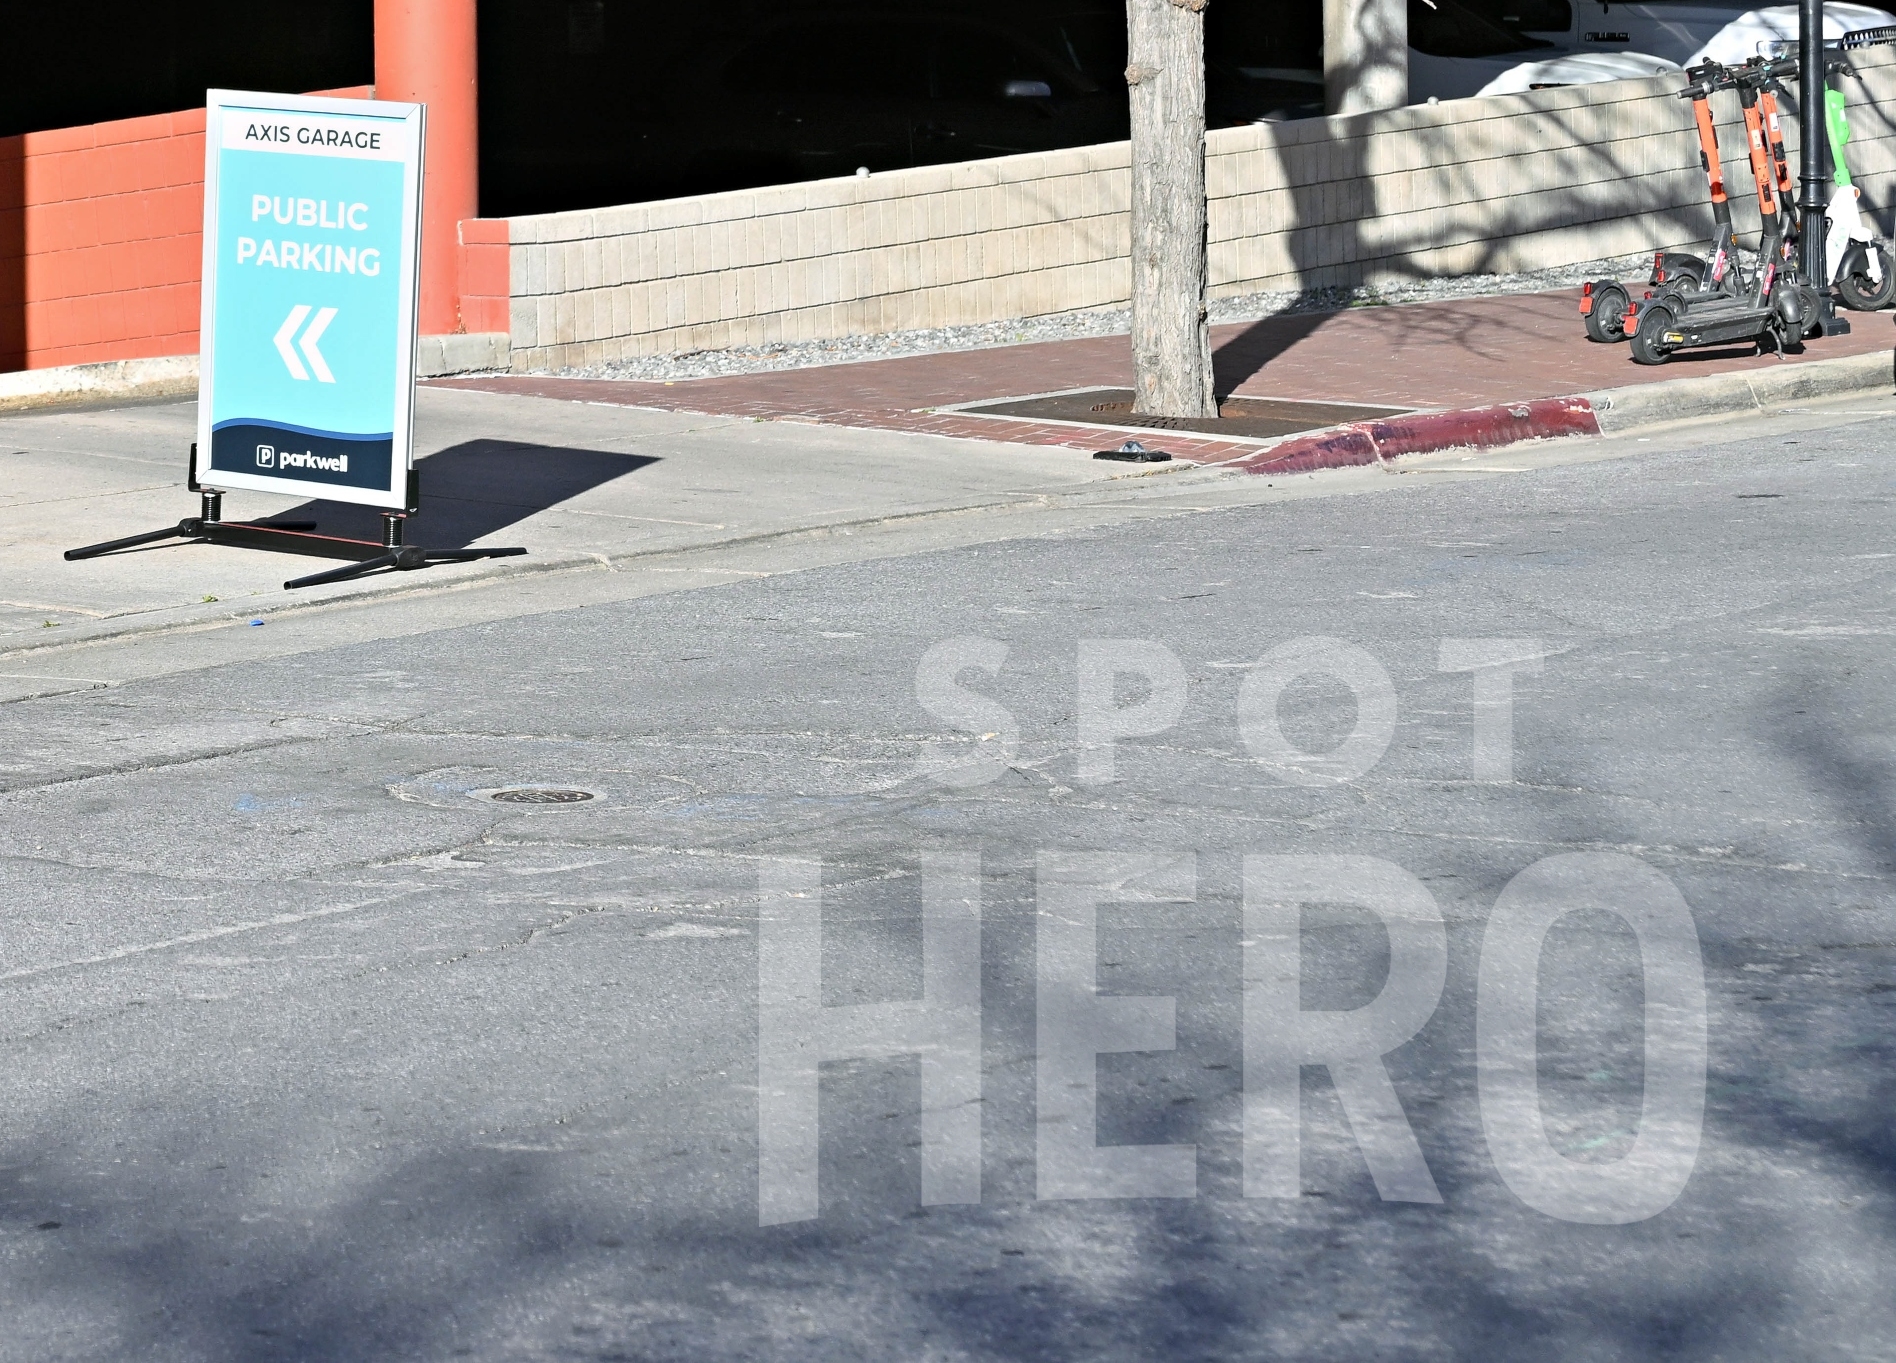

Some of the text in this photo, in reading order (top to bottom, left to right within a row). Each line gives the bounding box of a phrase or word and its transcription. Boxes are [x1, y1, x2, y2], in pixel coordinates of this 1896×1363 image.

[245, 123, 381, 150] AXIS GARAGE
[251, 193, 369, 231] PUBLIC
[236, 236, 381, 277] PARKING
[279, 450, 348, 473] parkwell
